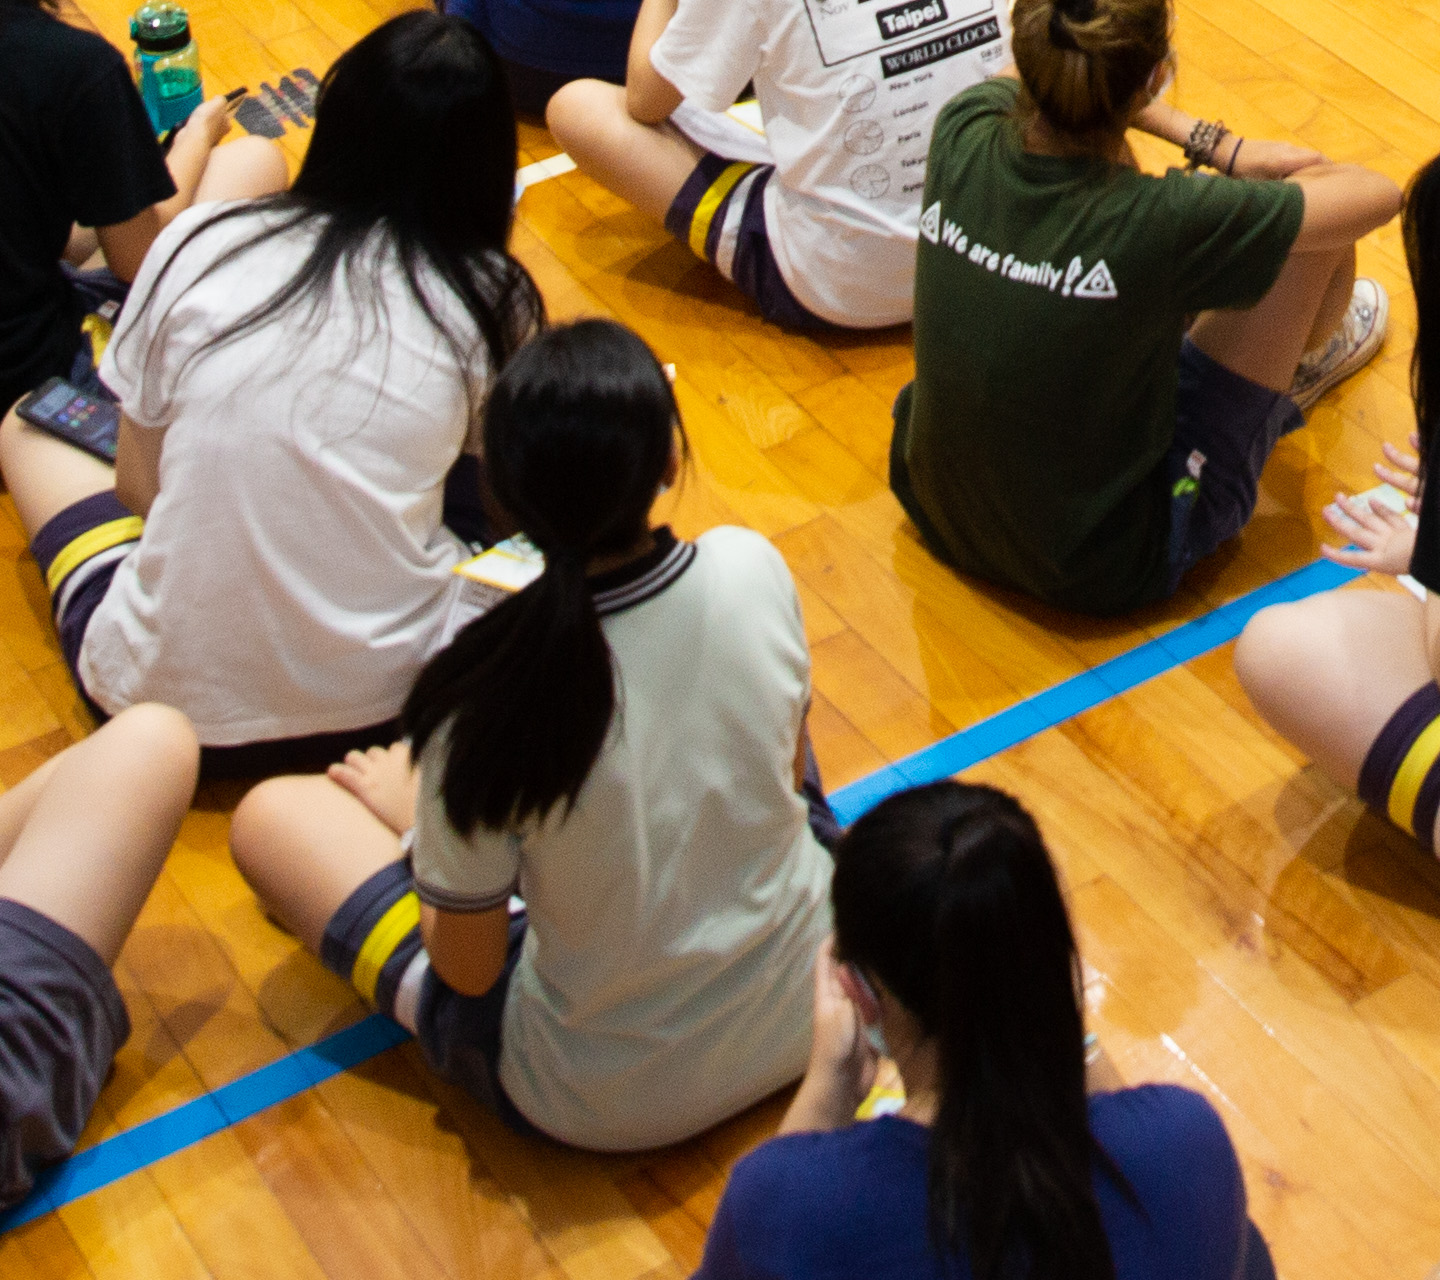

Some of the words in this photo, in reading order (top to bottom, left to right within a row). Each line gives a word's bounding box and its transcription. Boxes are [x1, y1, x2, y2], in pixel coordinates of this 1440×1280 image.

[882, 0, 942, 34] Taipei
[885, 41, 944, 72] WORLD
[946, 20, 999, 52] CLOCKS
[889, 79, 911, 91] New
[913, 71, 933, 84] York
[941, 219, 967, 254] We
[968, 241, 999, 271] are
